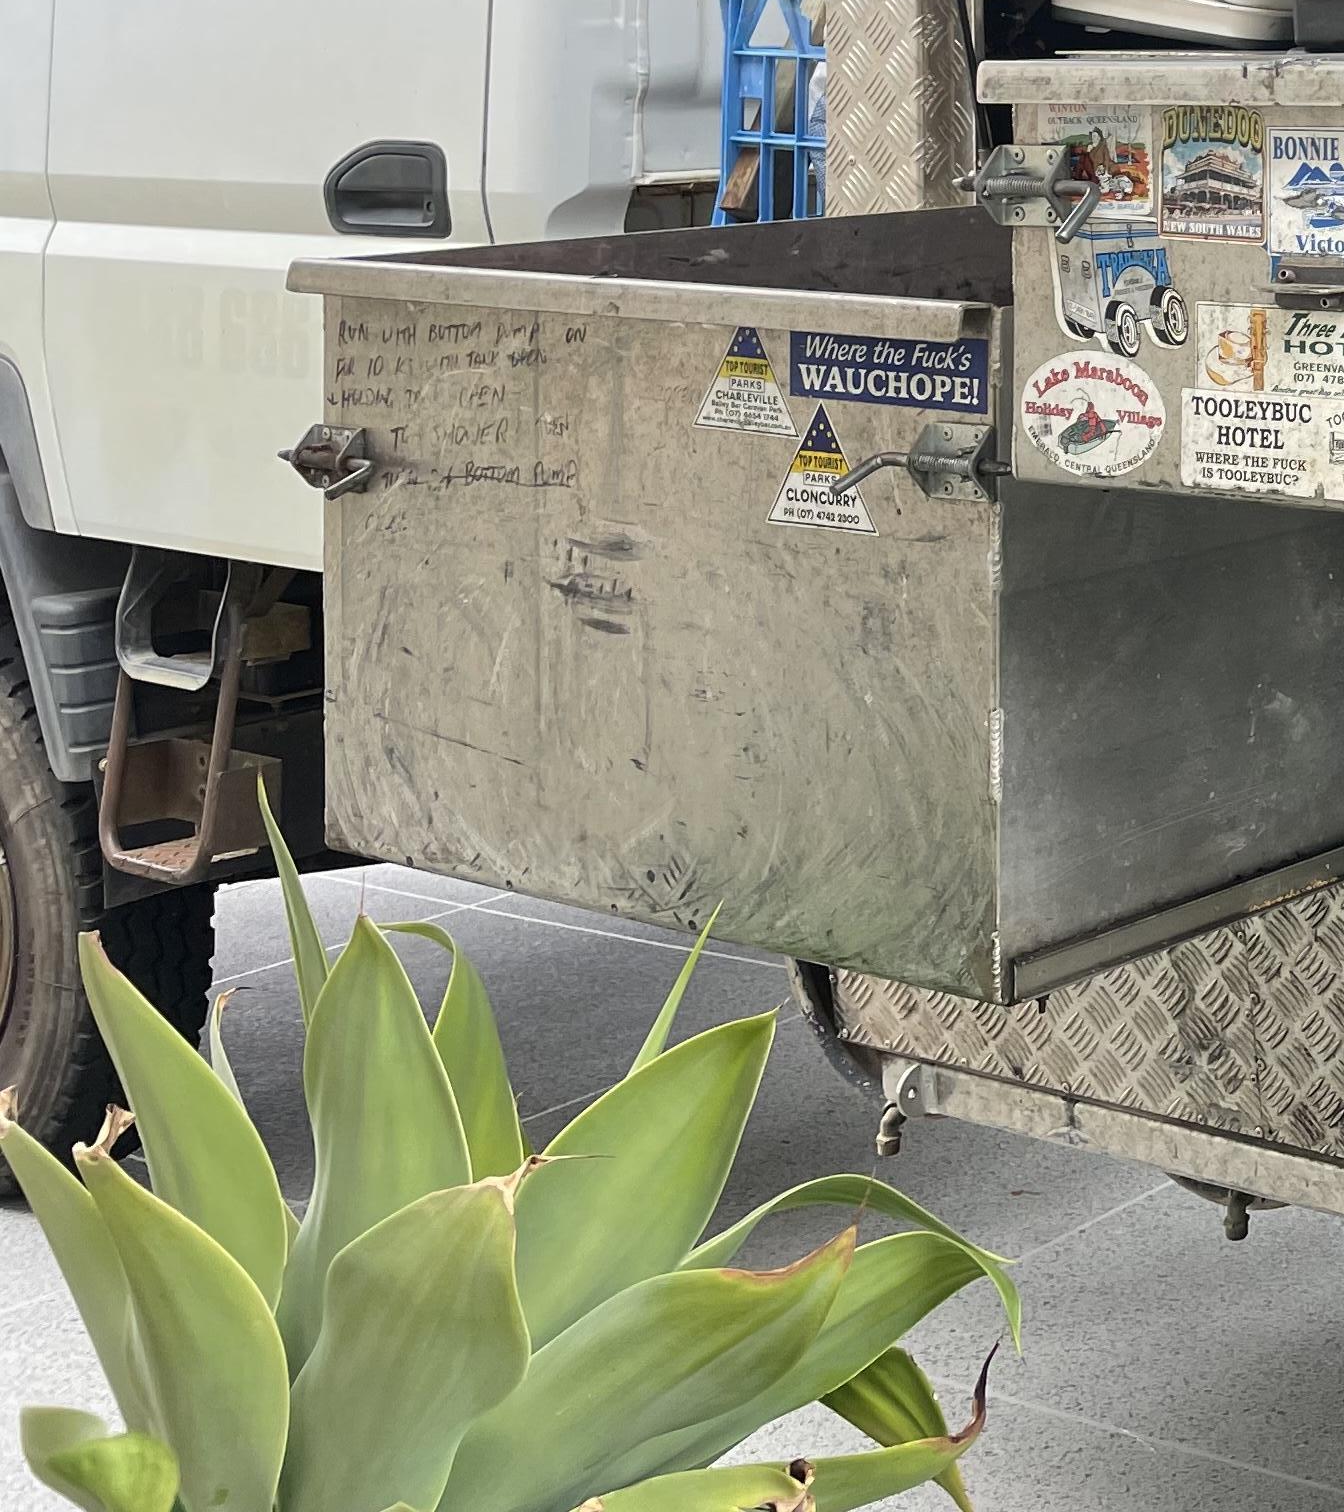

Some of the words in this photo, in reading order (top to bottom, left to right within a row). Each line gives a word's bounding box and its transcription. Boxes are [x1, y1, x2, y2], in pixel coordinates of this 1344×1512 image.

[1162, 105, 1264, 147] DUNEDOO
[1273, 137, 1338, 161] BONNIE
[1163, 221, 1186, 233] NEW
[1189, 223, 1223, 235] SOUTH
[1226, 225, 1262, 238] WALES
[1285, 313, 1336, 337] Three
[805, 336, 866, 363] Where
[873, 341, 905, 365] the
[912, 344, 972, 371] Fuck's
[726, 361, 738, 371] TOP
[740, 362, 768, 375] TOURIST
[1294, 374, 1315, 383] (07)
[731, 379, 762, 390] PARKS
[798, 363, 980, 406] WAUCHOPE!
[1033, 368, 1070, 398] Lake
[1074, 361, 1149, 406] Maraboon
[716, 390, 778, 405] CHARLEVILLE
[1025, 402, 1074, 420] Holiday
[1116, 410, 1162, 429] Village
[1192, 396, 1311, 423] TOOLEYBUC
[1216, 425, 1285, 449] HOTEL
[799, 454, 812, 466] TOP
[1106, 439, 1155, 473] QUEENSLAND
[1195, 452, 1238, 466] WHERE
[1243, 455, 1268, 468] THE
[1272, 458, 1307, 471] FUCK
[1202, 467, 1212, 479] IS
[1217, 469, 1300, 485] TOOLEYBUC?
[786, 487, 857, 508] CLONCURRY
[784, 508, 794, 518] PH
[797, 508, 814, 521] (07)
[817, 512, 836, 522] 4742
[837, 514, 860, 524] 2300
